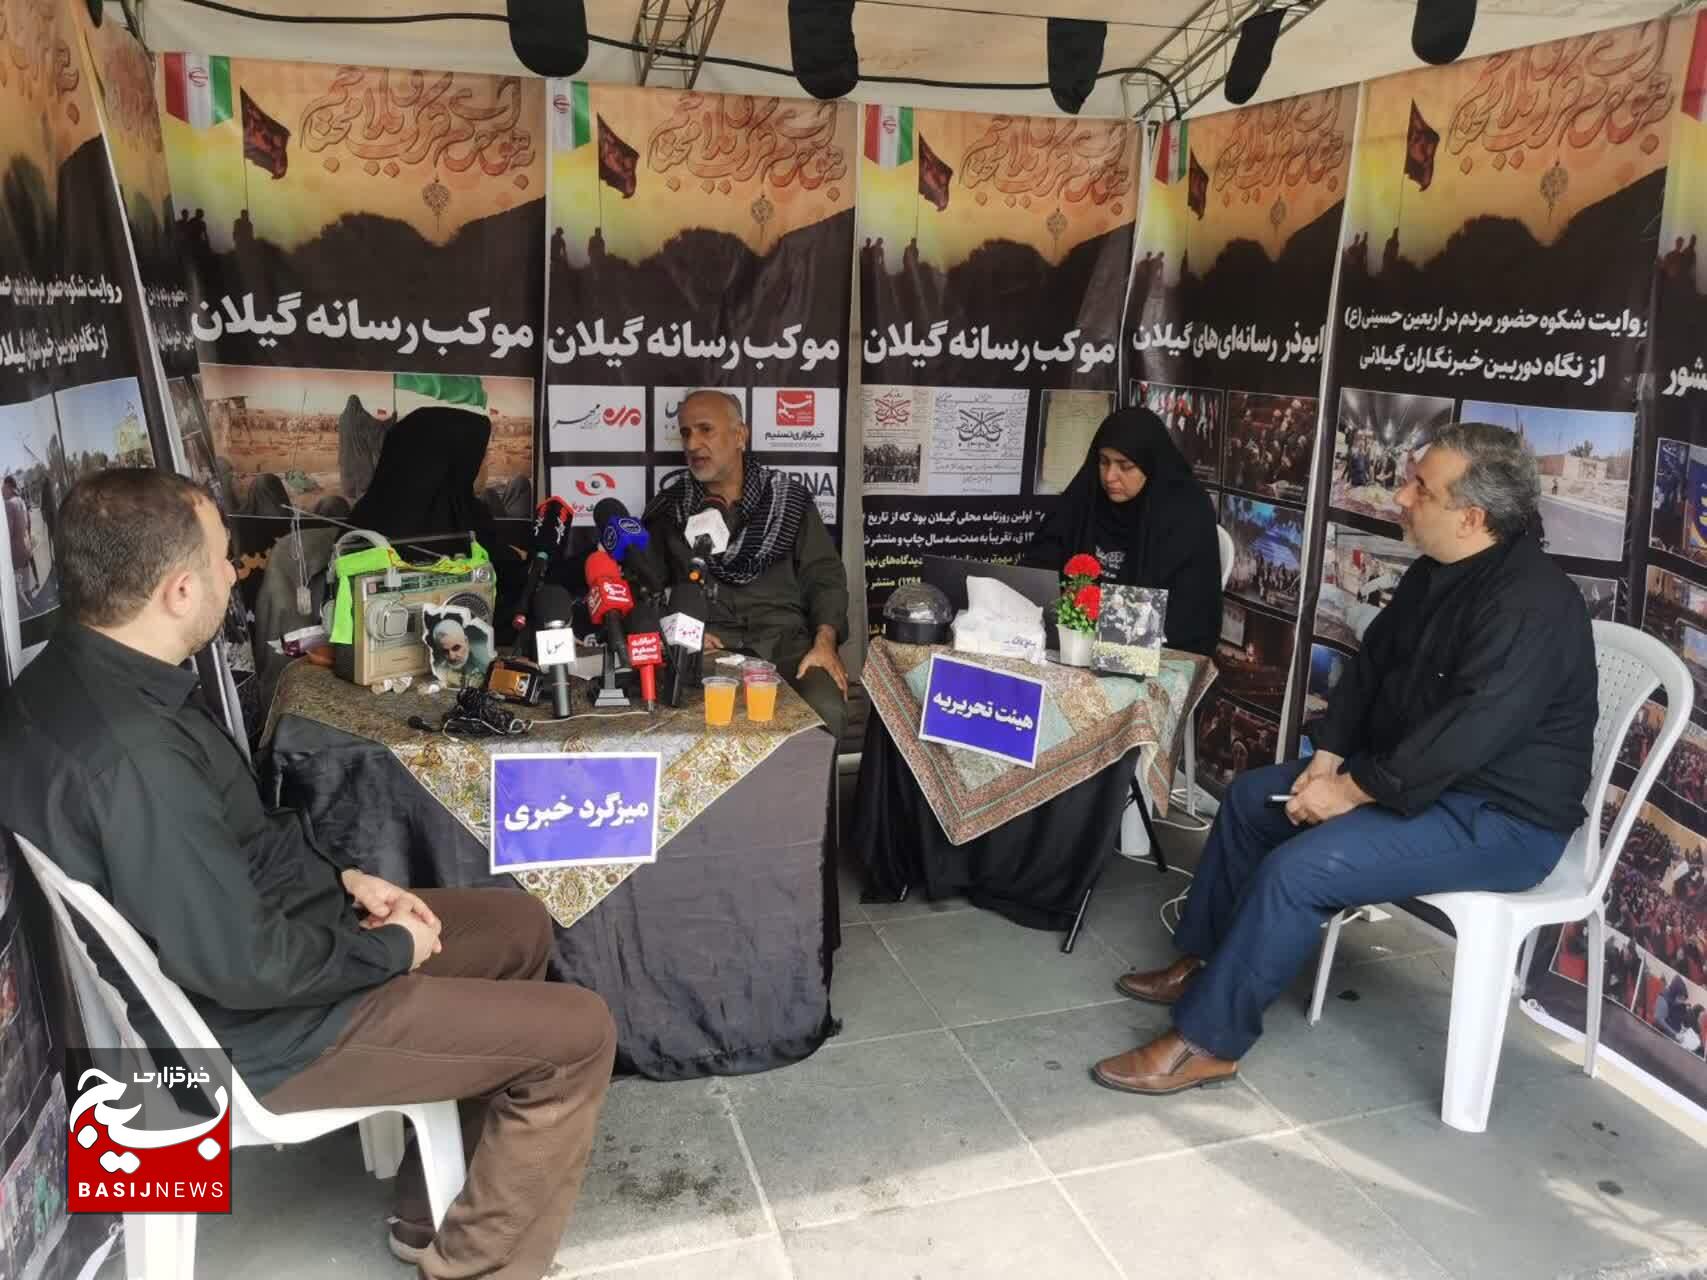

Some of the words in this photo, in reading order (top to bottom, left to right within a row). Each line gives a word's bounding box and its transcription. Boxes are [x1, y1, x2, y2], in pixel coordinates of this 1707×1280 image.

[191, 291, 302, 348] گیلان
[306, 299, 420, 354] رسانه
[1402, 306, 1443, 331] اربعین
[1442, 311, 1458, 331] در
[1457, 311, 1493, 334] مردم
[1492, 308, 1539, 333] حضور
[1540, 308, 1586, 335] شکوه
[422, 307, 534, 359] موکب
[547, 316, 644, 368] گیلان
[647, 320, 740, 369] رسانه
[863, 320, 949, 367] گیلان
[1133, 321, 1193, 356] گیلان
[743, 323, 840, 371] موکب
[949, 324, 1030, 371] رسانه
[1032, 329, 1115, 373] موکب
[1360, 344, 1406, 373] گیلانی
[1404, 345, 1484, 376] خبرنگاران
[1483, 357, 1543, 382] دوربین
[1544, 352, 1584, 378] نگاه
[1584, 355, 1606, 386] از
[889, 511, 899, 525] از
[899, 511, 912, 522] که
[912, 512, 927, 525] بود
[927, 510, 956, 525] گیلان
[956, 511, 981, 525] محلی
[982, 511, 1009, 524] روزنامه
[1011, 510, 1033, 524] اولین
[903, 533, 925, 548] چاپ
[925, 533, 944, 546] سال
[959, 533, 979, 543] مدت
[979, 534, 989, 544] به
[932, 692, 994, 721] تحریریه
[993, 703, 1034, 730] هیئت
[504, 795, 574, 831] خبری
[579, 792, 649, 827] میزگرد
